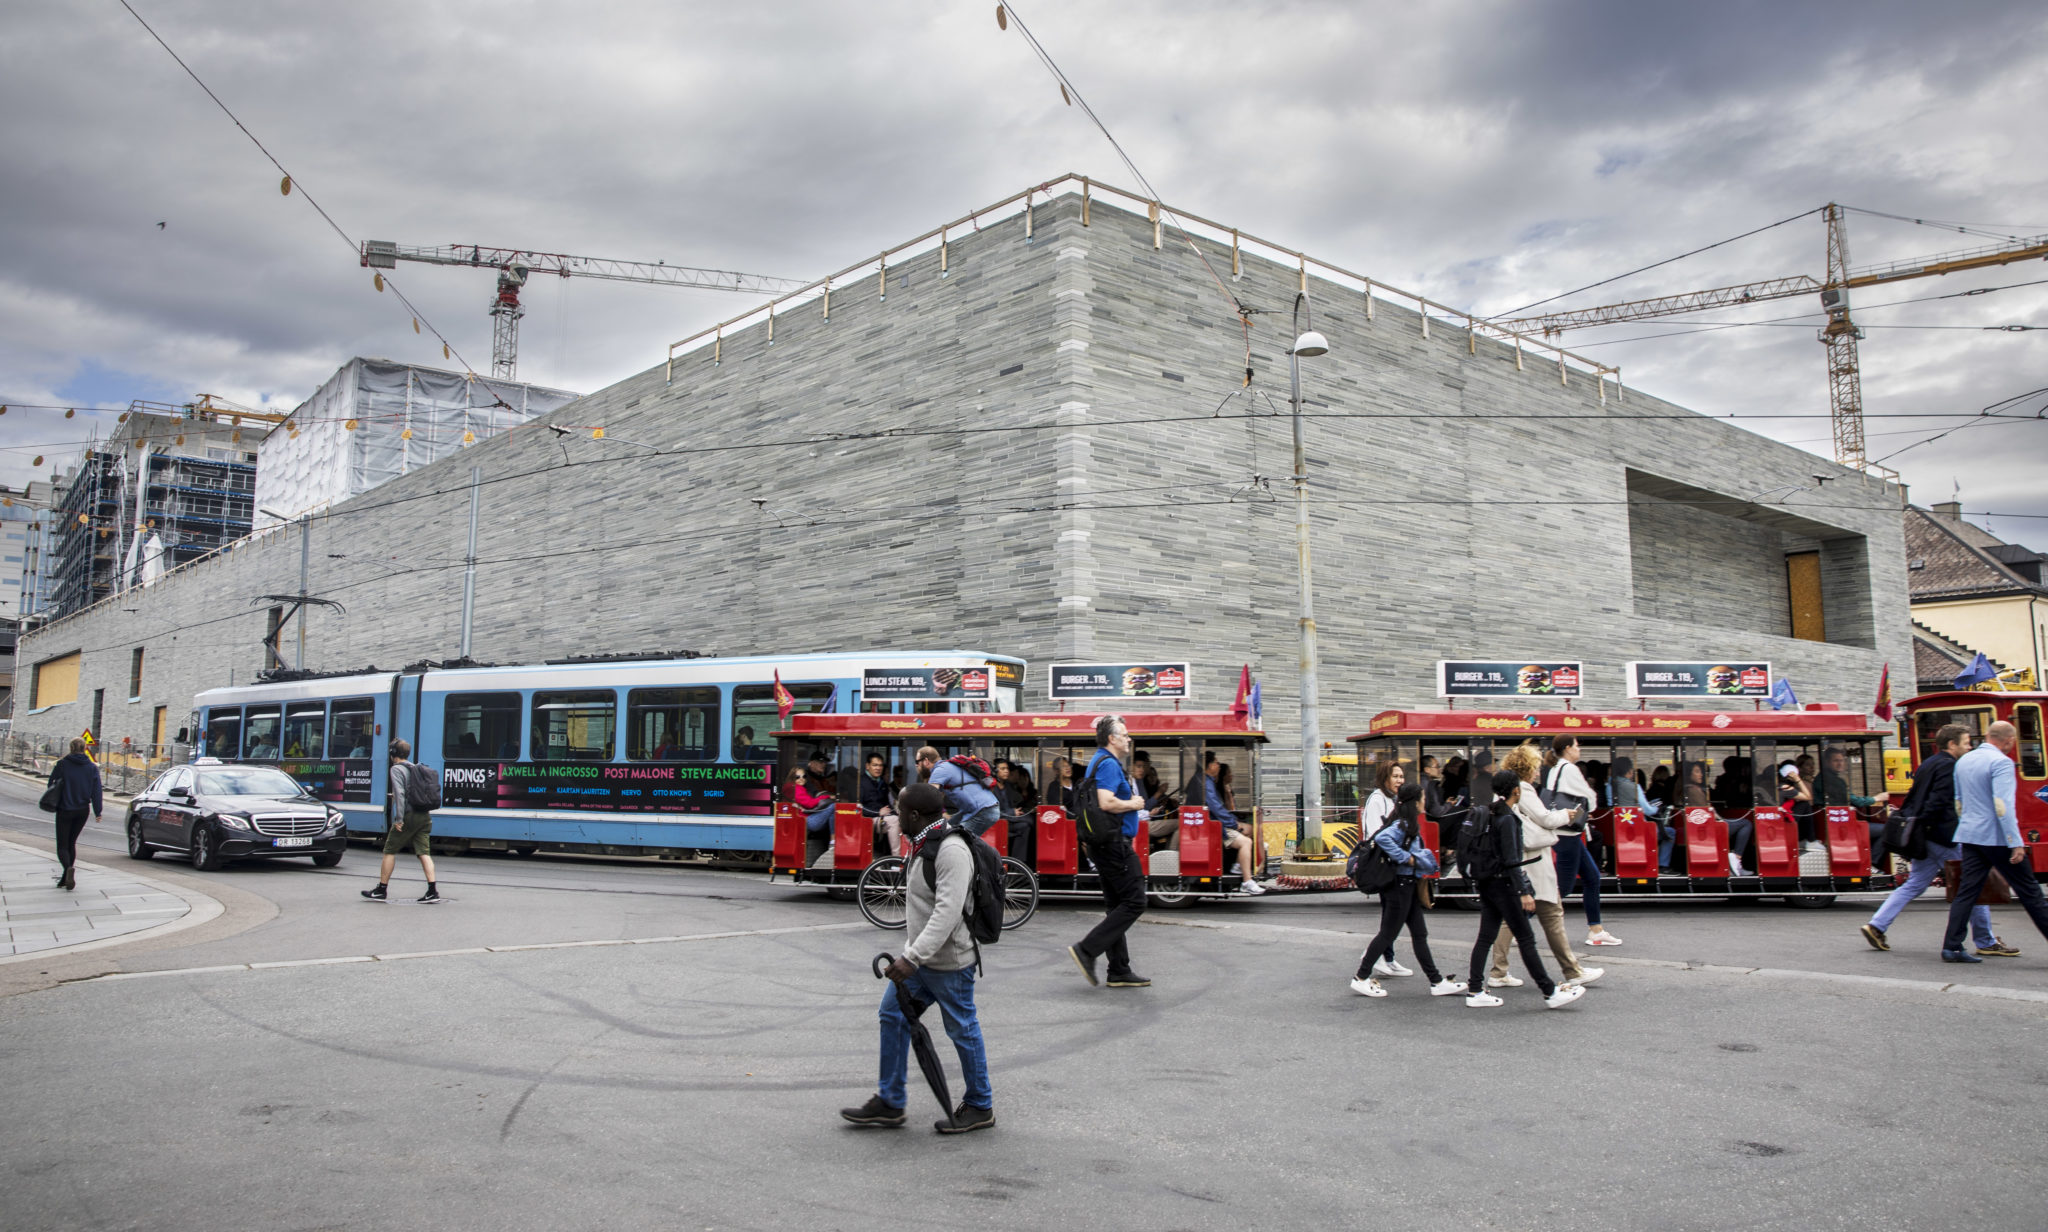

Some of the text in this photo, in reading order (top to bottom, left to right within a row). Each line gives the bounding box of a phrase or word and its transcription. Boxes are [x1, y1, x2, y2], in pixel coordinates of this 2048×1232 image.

[1061, 675, 1088, 684] BURGER
[1455, 672, 1484, 681] BURGER
[1645, 672, 1674, 682] BURGER
[865, 677, 887, 686] LUNCH
[888, 677, 910, 685] STEAK
[444, 768, 486, 783] FNDNGS
[502, 766, 537, 777] AXWELL
[550, 766, 599, 778] INGROSSO
[604, 767, 675, 779] POST MALONE
[681, 768, 767, 780] STEVE ANGELLO
[528, 786, 547, 794] DAGNY
[581, 787, 610, 795] LAURITZEN
[652, 789, 692, 797] OTTO KNOWS
[703, 790, 725, 798] SIGRID
